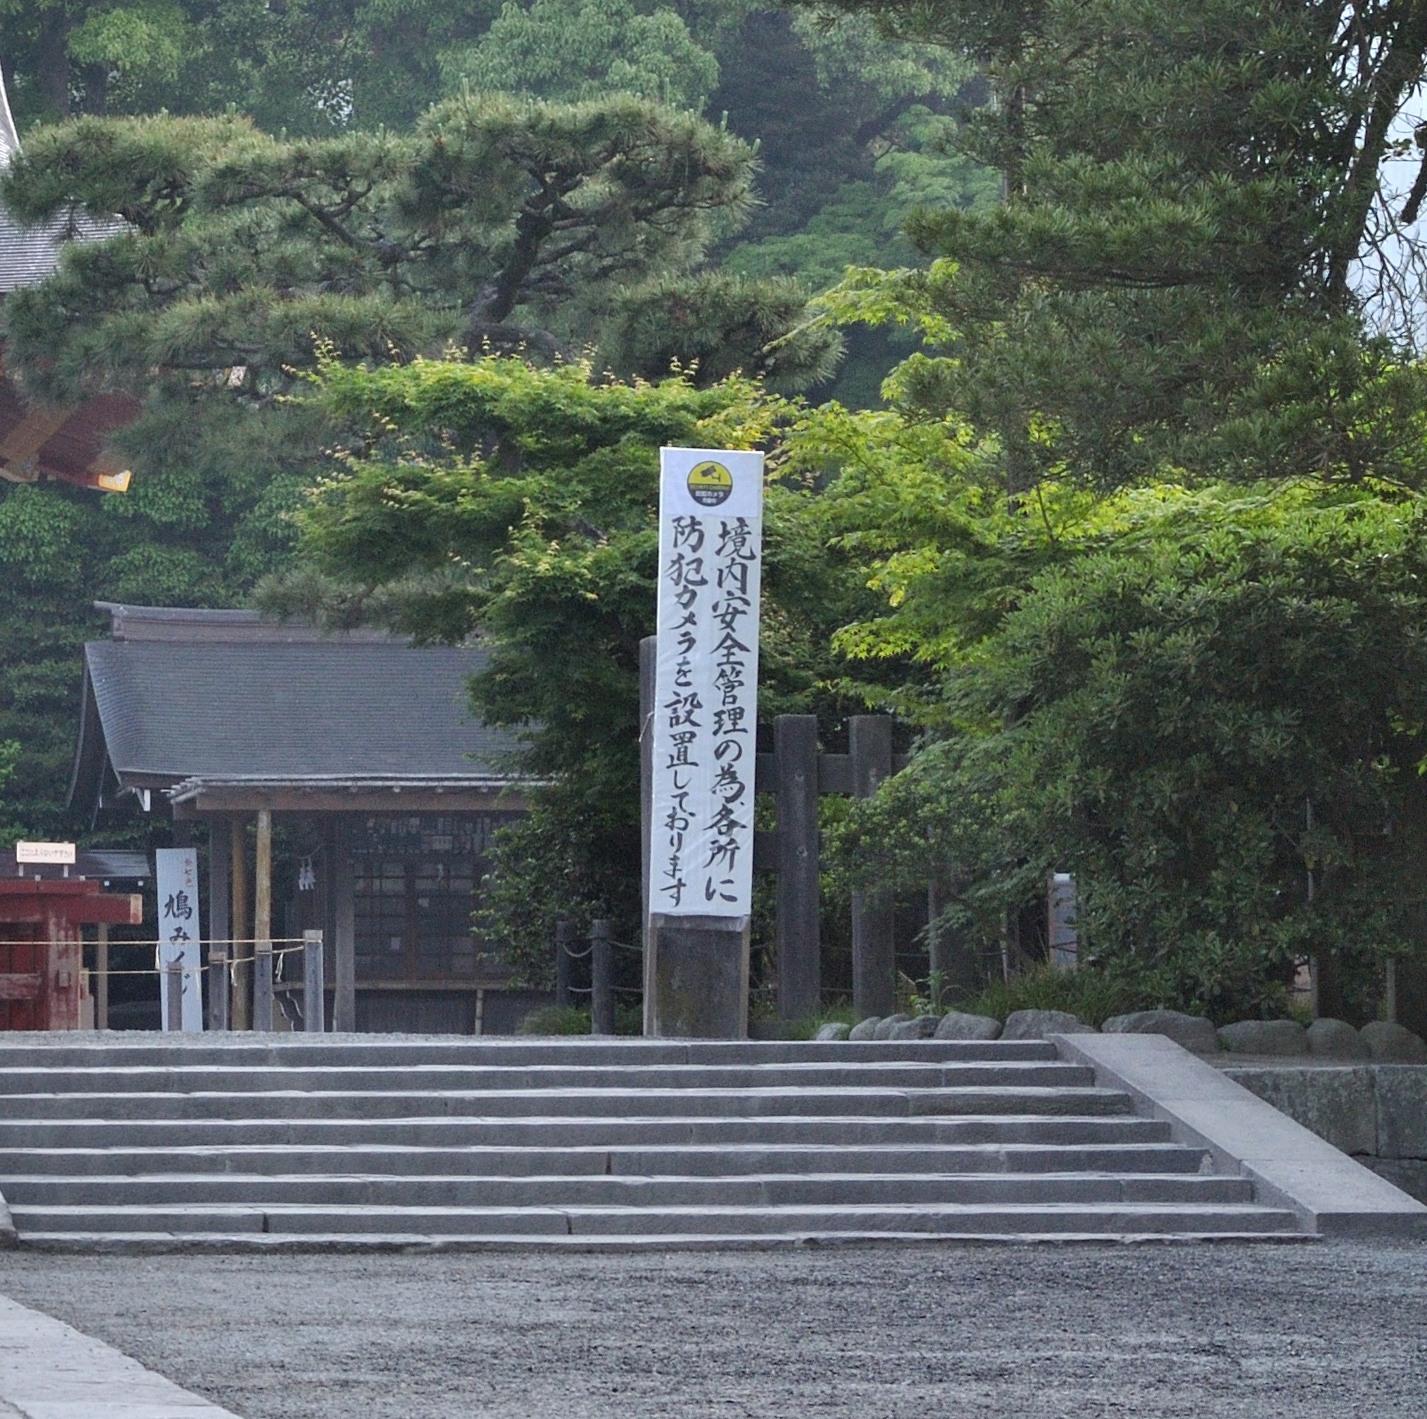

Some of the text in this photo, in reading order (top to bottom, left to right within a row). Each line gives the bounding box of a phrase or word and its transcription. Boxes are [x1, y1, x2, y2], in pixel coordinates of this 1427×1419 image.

[660, 515, 709, 908] 防犯カメラを設置しております
